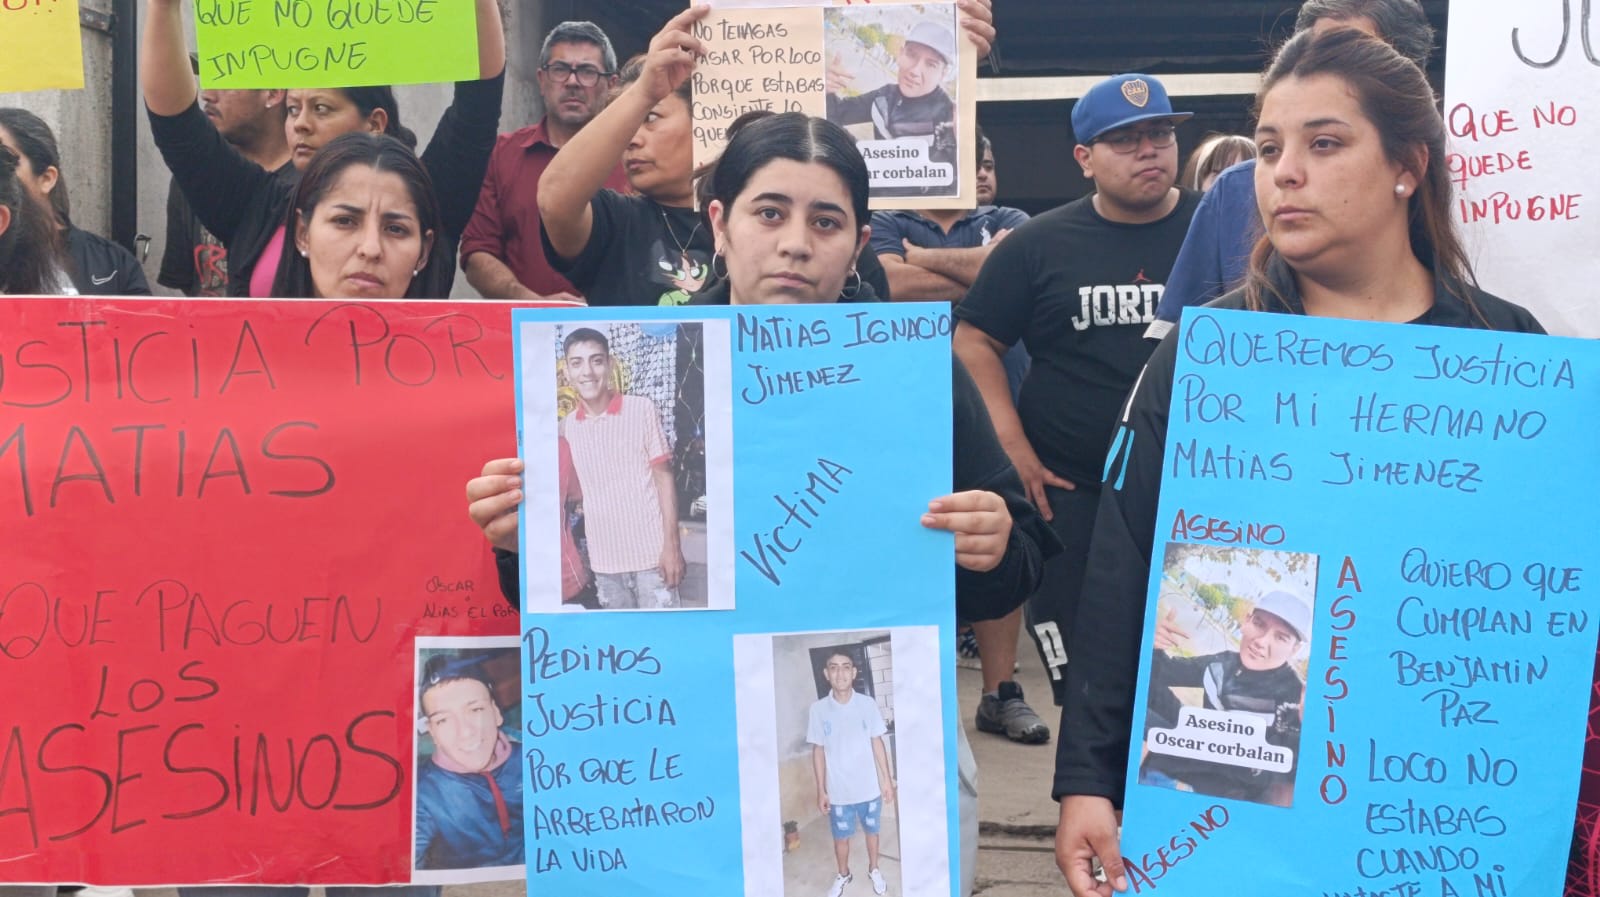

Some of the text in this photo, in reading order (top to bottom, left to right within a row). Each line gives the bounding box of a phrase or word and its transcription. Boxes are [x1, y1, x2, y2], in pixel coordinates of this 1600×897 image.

[197, 0, 438, 30] QUE NO QUEDE
[693, 19, 713, 41] NO
[206, 42, 367, 80] INPUGNE
[748, 45, 786, 65] POR
[789, 46, 821, 64] LOCO
[692, 72, 754, 101] PORQUE
[1448, 101, 1577, 142] QUE NO
[863, 145, 919, 159] Asesino
[1445, 150, 1533, 190] QUEDE
[882, 165, 946, 179] corbalan
[1459, 191, 1582, 225] INPUGNE
[305, 303, 504, 386] POR
[1184, 315, 1394, 372] QUEREMOS
[1178, 374, 1246, 424] POR
[1350, 391, 1548, 441] HERMANO
[1170, 508, 1285, 545] ASESINO
[426, 576, 474, 593] OSCAR
[1523, 562, 1584, 601] QUE
[0, 578, 382, 660] QUE PAGUEN
[467, 606, 487, 618] EL
[1396, 596, 1588, 642] CUMPLAN EN
[91, 660, 219, 720] LOS
[1421, 688, 1499, 728] PAZ
[1184, 713, 1255, 737] Asesino
[1154, 731, 1285, 765] Oscar corbalan
[1368, 738, 1518, 787] LOCO NO
[526, 747, 684, 794] POR QUE LE
[536, 847, 563, 873] LA
[1357, 845, 1479, 879] CUANDO
